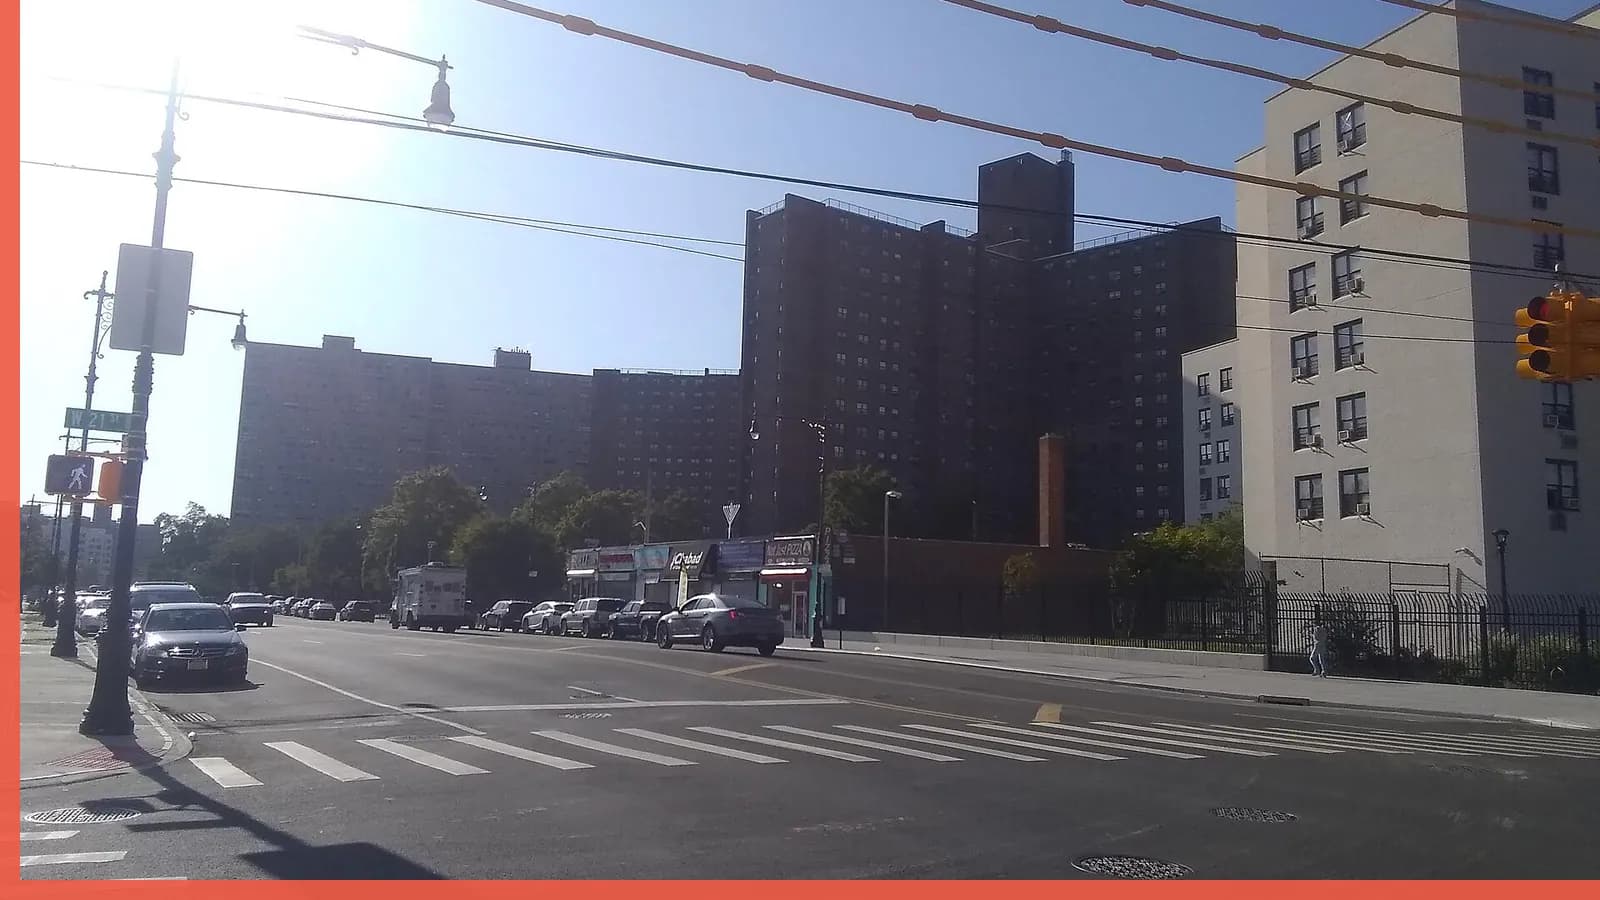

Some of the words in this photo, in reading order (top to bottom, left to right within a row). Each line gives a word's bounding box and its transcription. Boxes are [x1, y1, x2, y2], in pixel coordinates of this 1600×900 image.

[72, 410, 83, 426] W
[89, 412, 105, 429] 21
[786, 543, 803, 556] PIZZA
